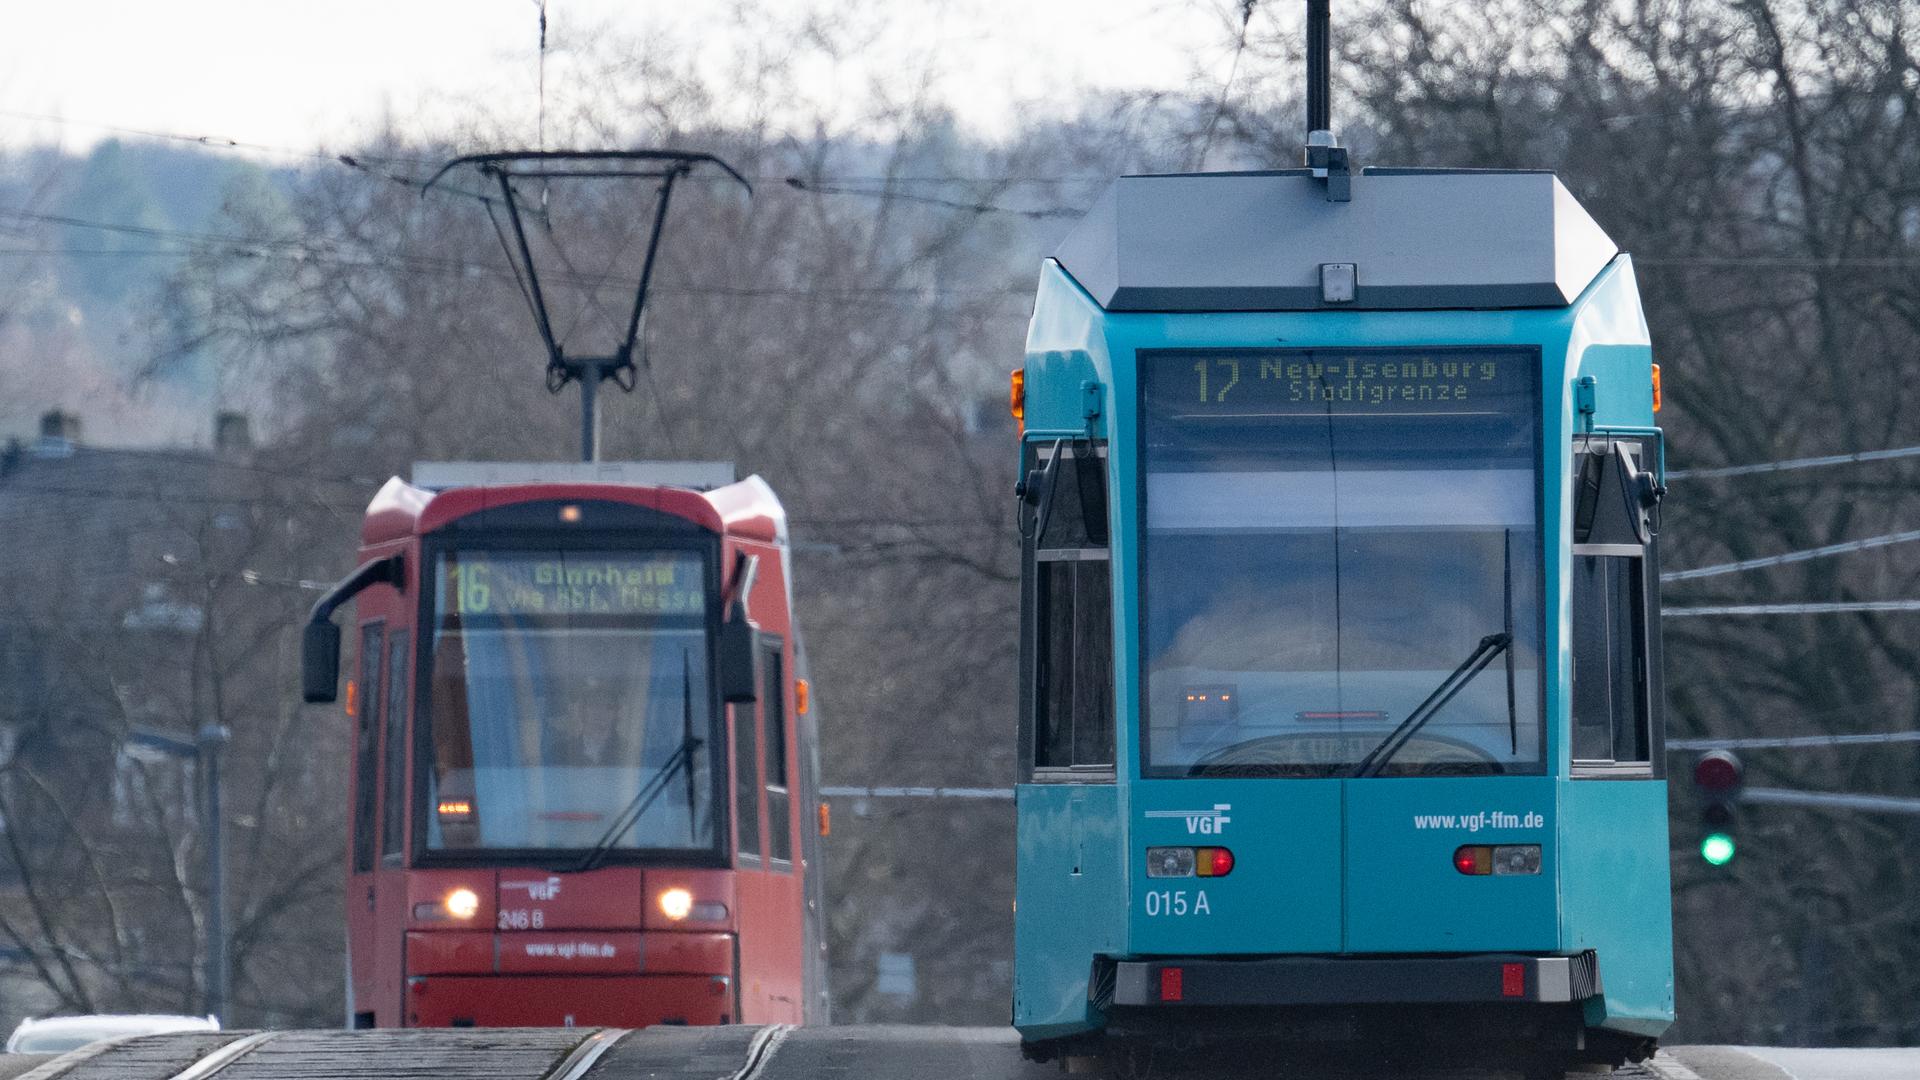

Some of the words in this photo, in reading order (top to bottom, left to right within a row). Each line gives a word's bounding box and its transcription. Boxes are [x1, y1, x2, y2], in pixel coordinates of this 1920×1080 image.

[1194, 359, 1240, 402] 17
[1260, 359, 1497, 380] Neu-Isenburg
[1290, 380, 1468, 403] Stadtgrenze
[449, 564, 491, 614] 16
[535, 563, 675, 585] Ginnheim
[1186, 804, 1231, 834] VGF
[1414, 811, 1544, 832] www.vgf-ffm.de
[1146, 891, 1188, 916] 015
[1193, 890, 1211, 915] A
